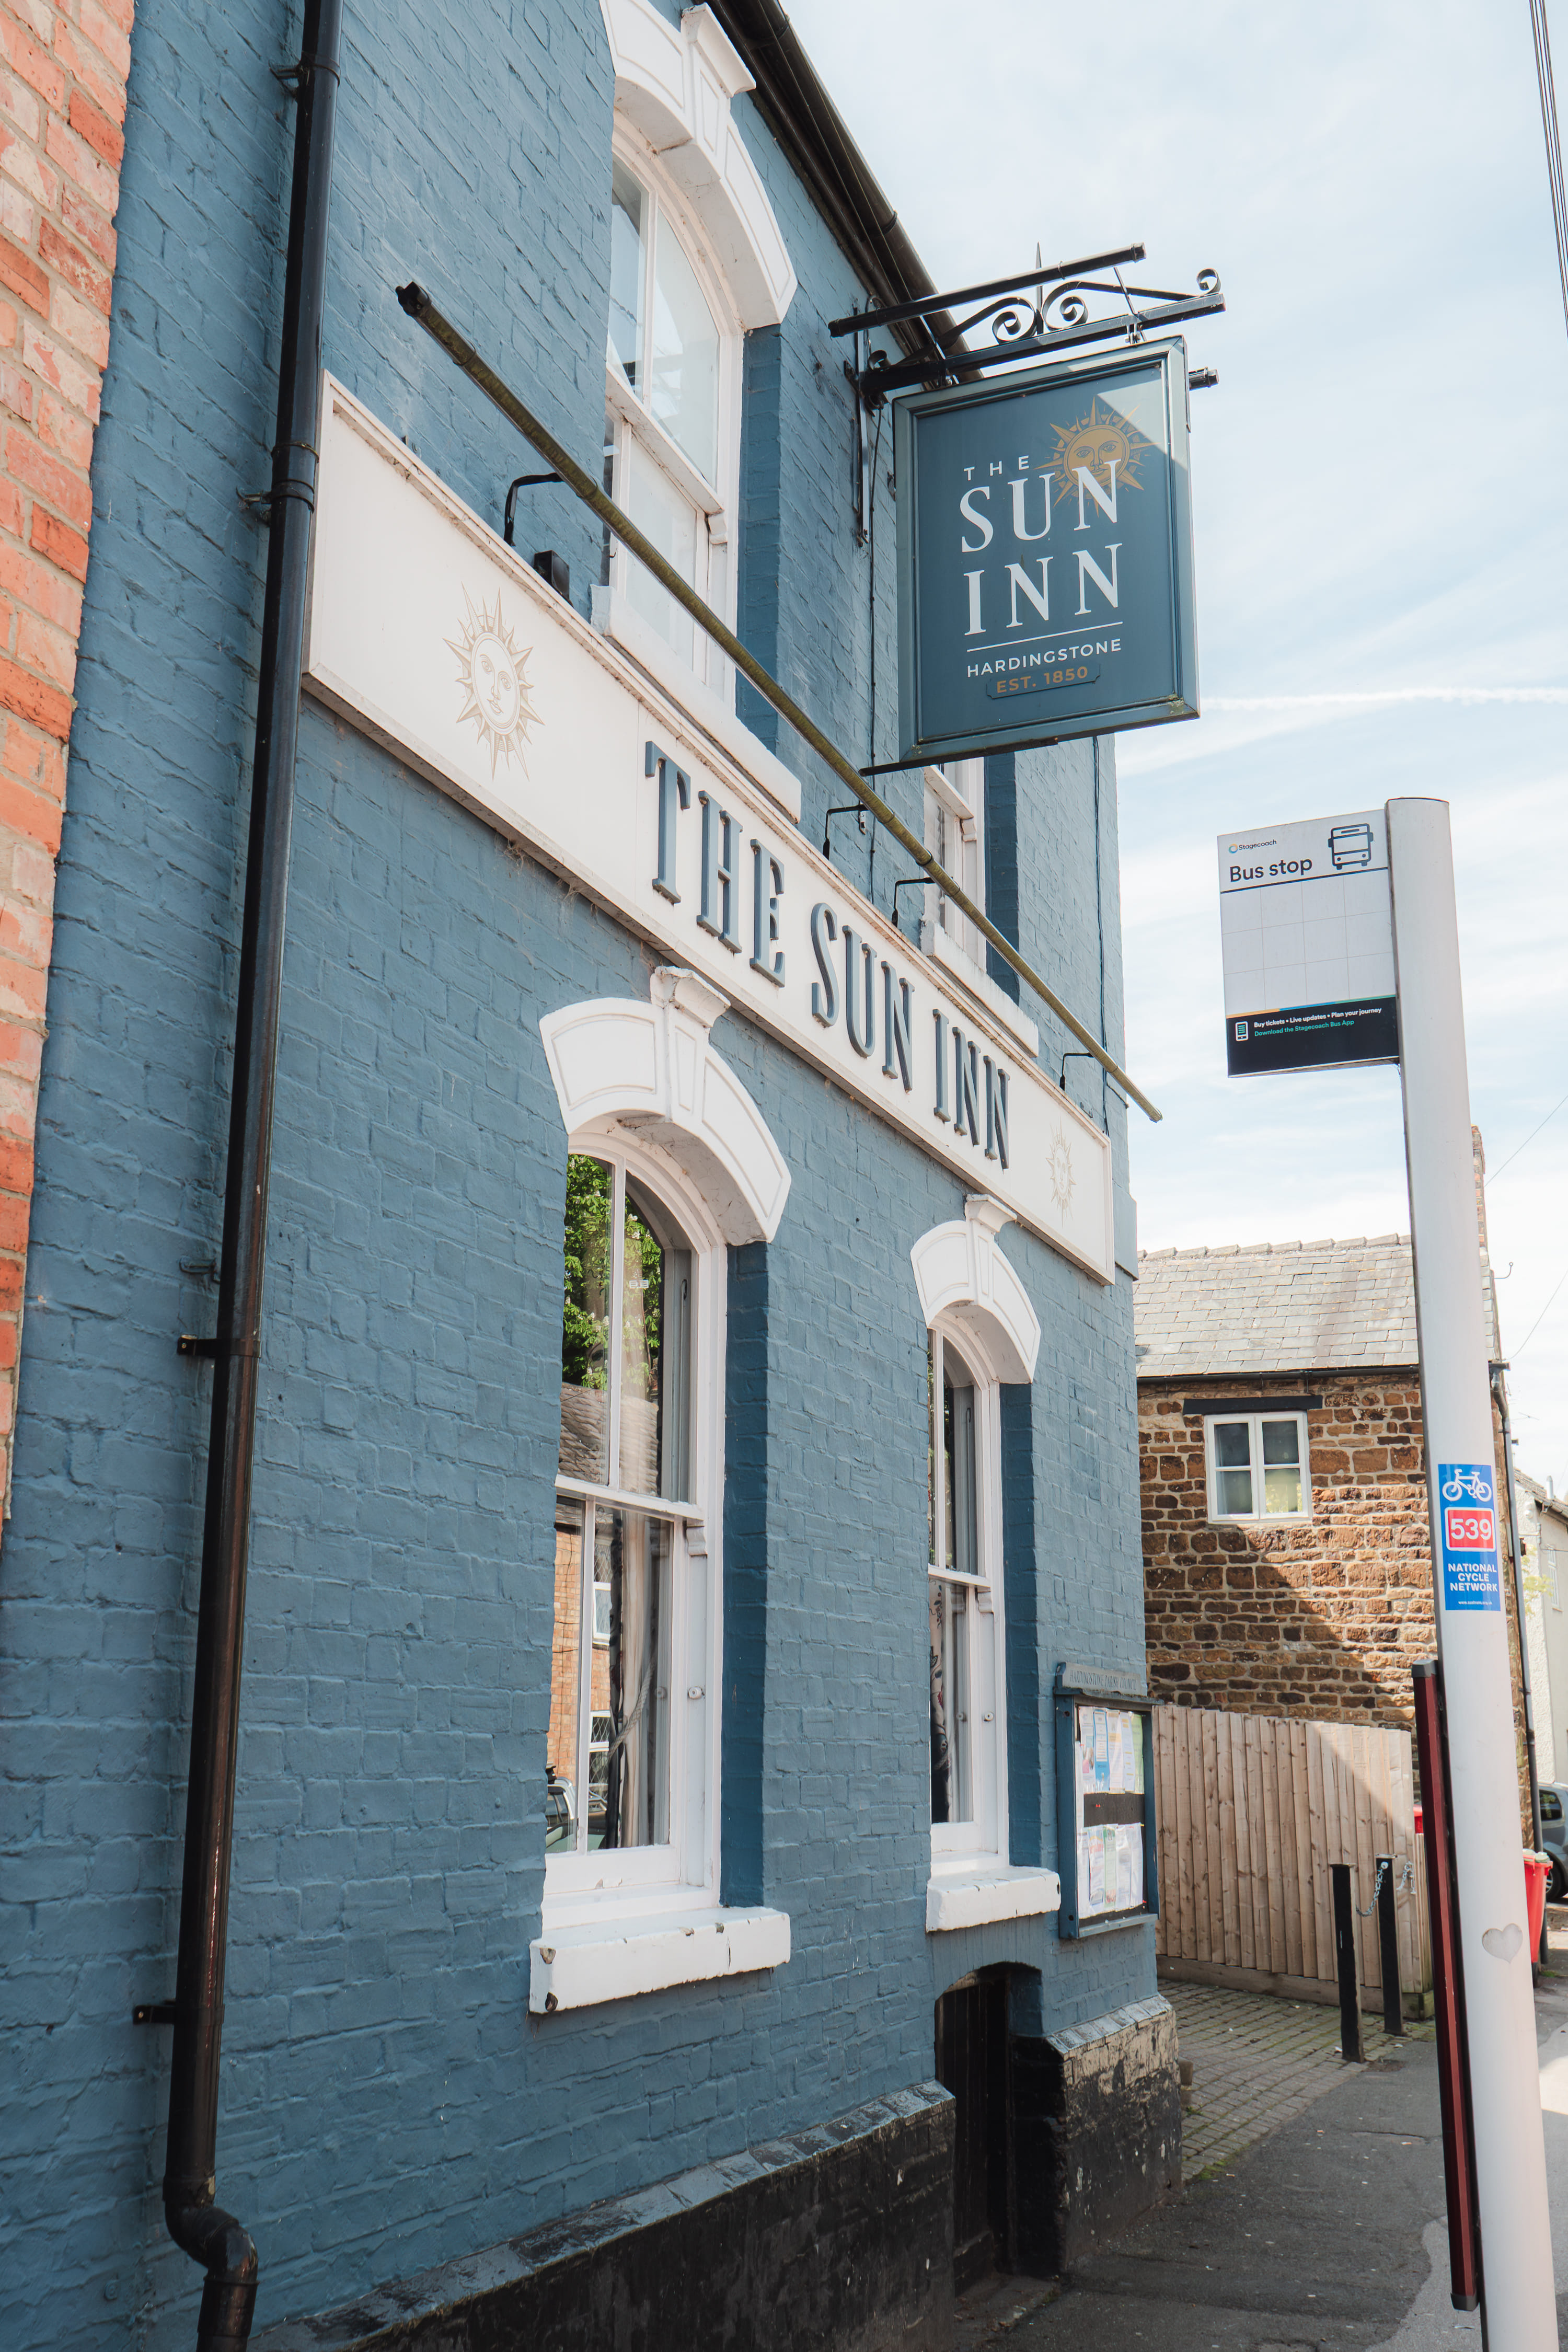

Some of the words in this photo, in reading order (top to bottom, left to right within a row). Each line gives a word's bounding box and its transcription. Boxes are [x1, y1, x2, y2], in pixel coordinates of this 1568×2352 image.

[964, 455, 1029, 481] THE
[960, 460, 1121, 552] SUN
[964, 543, 1122, 636] INN
[967, 638, 1122, 678] HARDINGSTONE
[996, 675, 1036, 694] EST.
[1044, 665, 1088, 685] 1850
[1239, 839, 1277, 850] Stagecoach
[1230, 866, 1264, 882] Bus
[1269, 859, 1312, 875] stop
[645, 741, 786, 988] THE
[811, 902, 915, 1092] SUN
[932, 1009, 1010, 1170] INN
[1255, 1028, 1283, 1036] Download
[1295, 1022, 1329, 1031] Stagecoach
[1451, 1518, 1491, 1540] 539
[1448, 1563, 1497, 1573] NATIONAL
[1458, 1573, 1489, 1582] CYCLE
[1450, 1582, 1498, 1592] NETWORK
[1070, 1670, 1104, 1686] HARDINGSTONE
[1105, 1675, 1119, 1688] PARISH
[1120, 1677, 1136, 1690] COUNCIL
